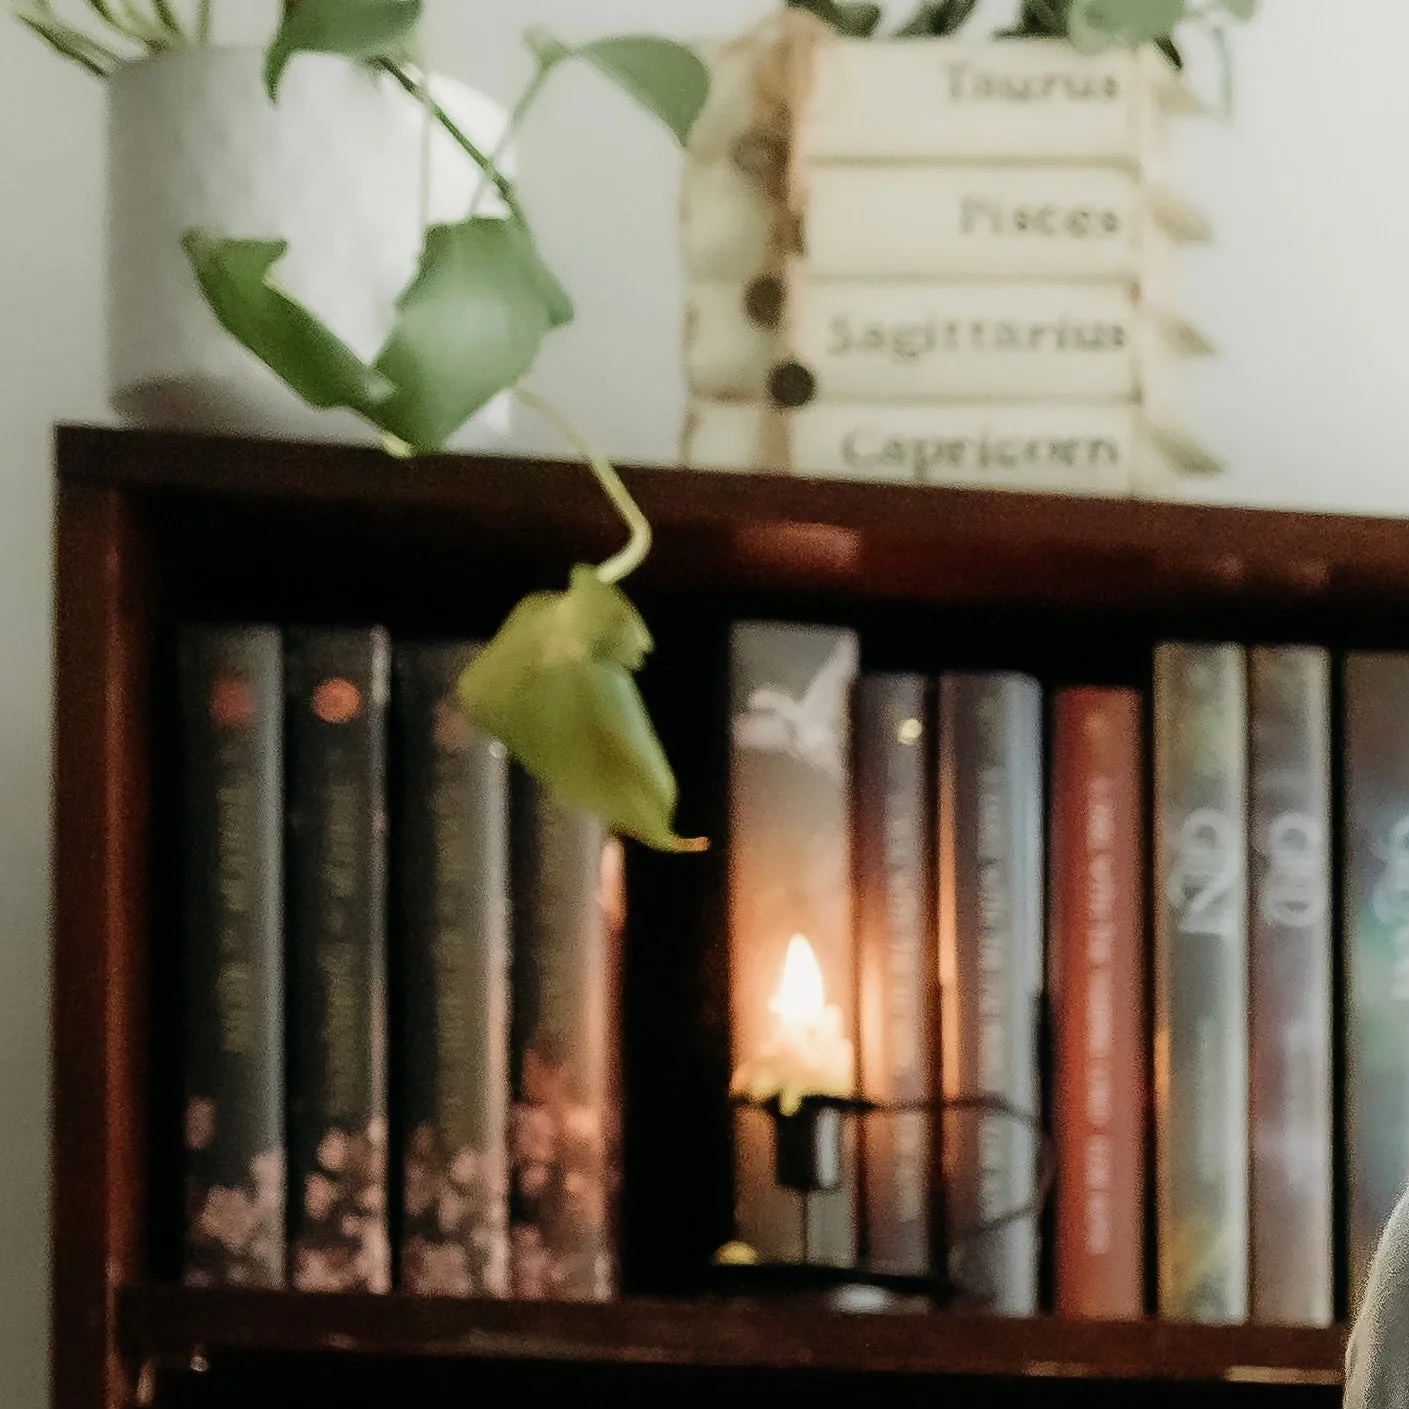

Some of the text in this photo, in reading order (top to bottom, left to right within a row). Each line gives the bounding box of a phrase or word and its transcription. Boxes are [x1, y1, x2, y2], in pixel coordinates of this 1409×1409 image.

[944, 58, 1119, 102] Taurus
[958, 194, 1119, 239] Pisces
[825, 314, 1128, 360] Sagittarius
[840, 427, 1119, 482] Capricorn
